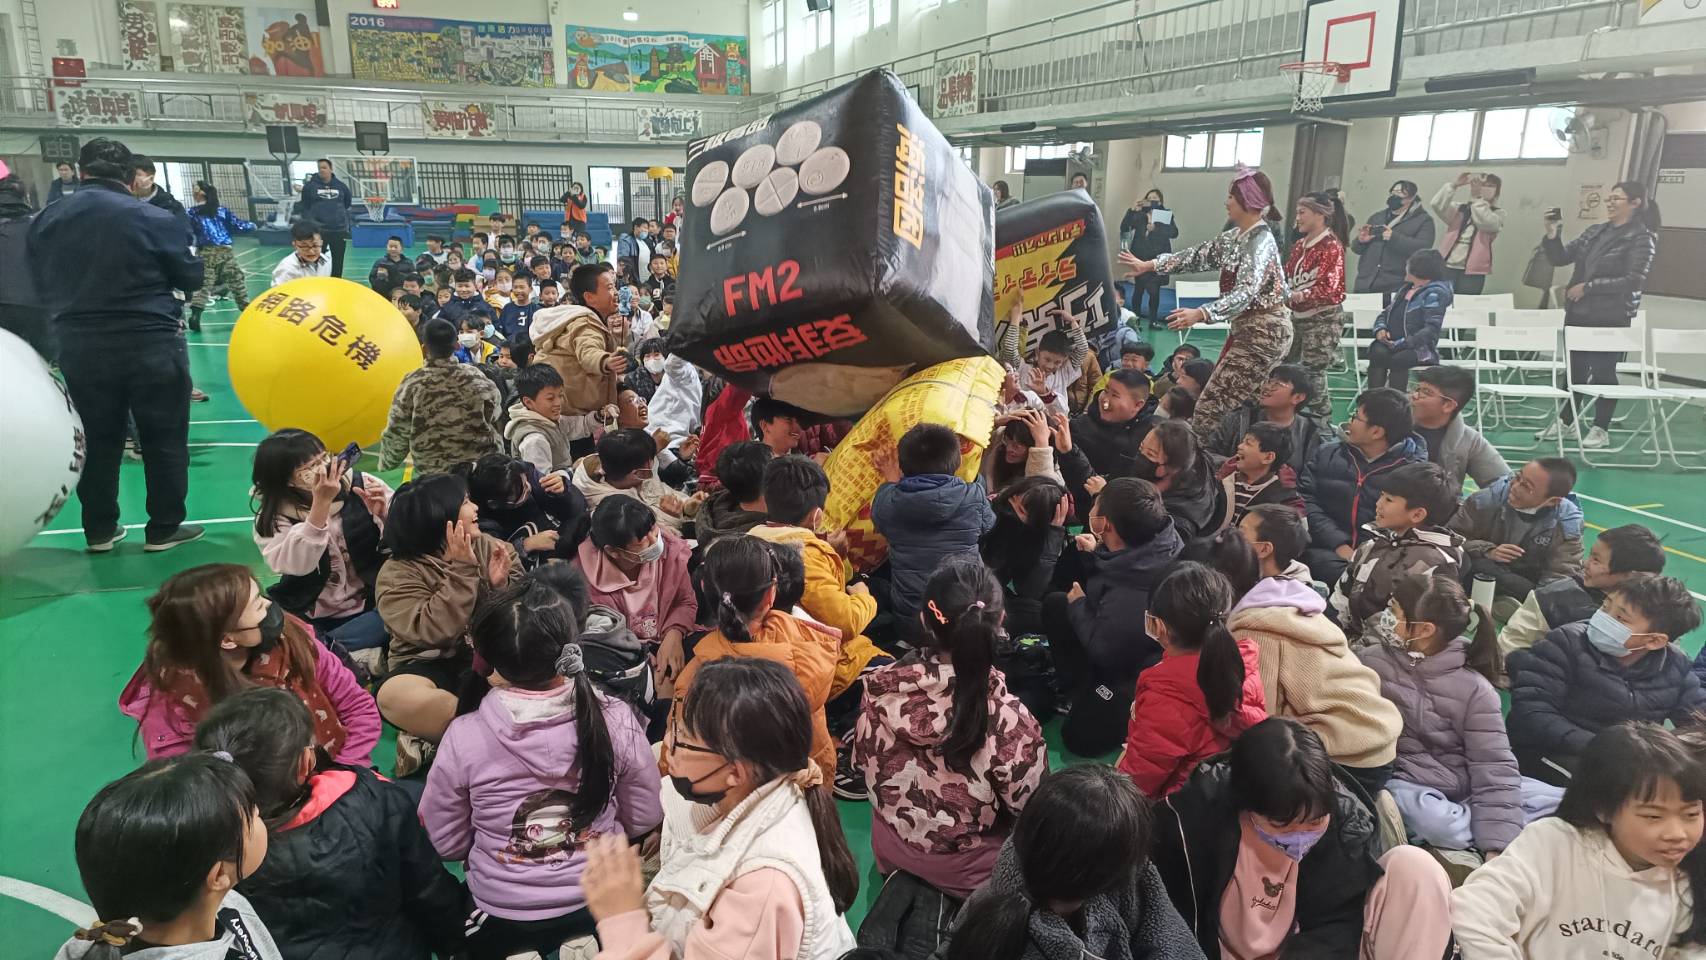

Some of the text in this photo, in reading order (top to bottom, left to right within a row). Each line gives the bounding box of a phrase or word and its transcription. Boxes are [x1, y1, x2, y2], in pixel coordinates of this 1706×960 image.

[350, 16, 385, 28] 2016
[723, 259, 803, 318] FM2
[254, 291, 381, 371] 網路危機
